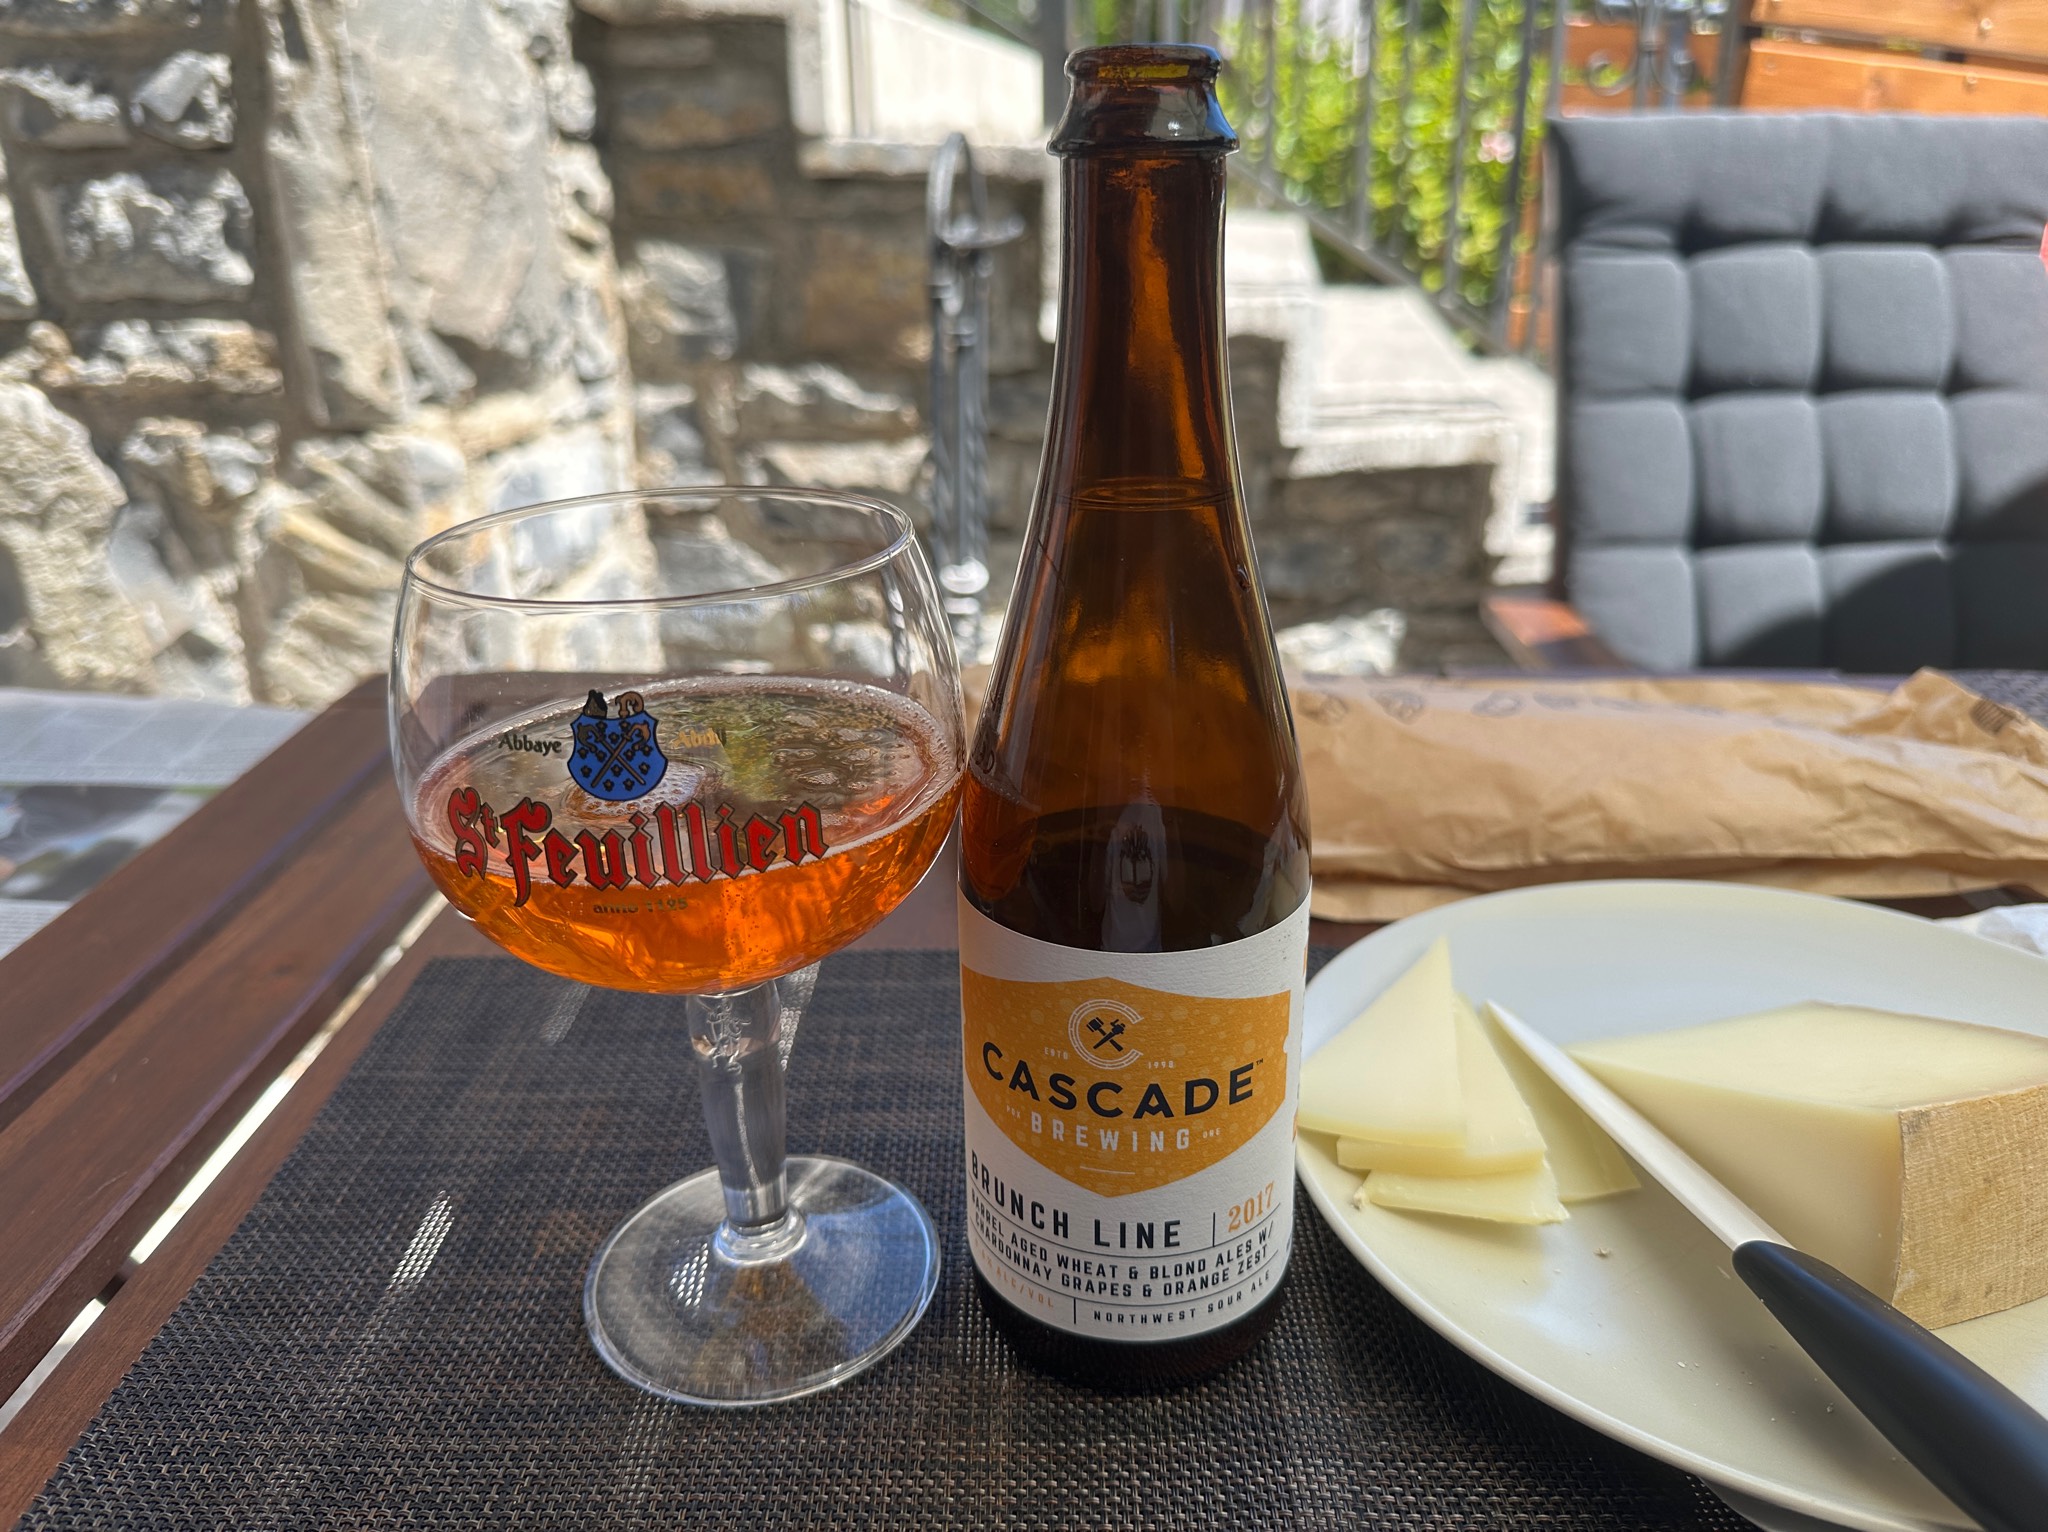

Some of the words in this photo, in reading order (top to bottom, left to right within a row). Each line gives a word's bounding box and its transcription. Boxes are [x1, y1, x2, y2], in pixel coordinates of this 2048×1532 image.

[497, 732, 562, 757] Abbaye
[592, 903, 639, 914] anno
[982, 1041, 1254, 1119] CASCADE
[1147, 1060, 1176, 1070] 1998
[1031, 1110, 1190, 1152] BREWING
[1202, 1127, 1222, 1139] ORE
[971, 1149, 1069, 1239] BRUNCH
[1094, 1218, 1181, 1249] LINE
[1228, 1180, 1276, 1233] 2017
[971, 1188, 1005, 1238] BARREL
[1011, 1231, 1048, 1262] AGED
[1056, 1252, 1119, 1279] WHEAT
[1128, 1266, 1139, 1280] &
[1149, 1258, 1206, 1280] BLOND
[1215, 1238, 1252, 1268] ALES
[1258, 1220, 1274, 1245] W/
[975, 1211, 1052, 1281] CHARDONNAY
[1061, 1273, 1132, 1297] GRAPES
[1142, 1284, 1153, 1298] &
[1163, 1267, 1230, 1297] ORANGE
[1237, 1243, 1268, 1276] ZEST
[1093, 1308, 1197, 1325] NORTHWEST
[1207, 1291, 1243, 1314] SOUR
[1250, 1269, 1270, 1293] ALE
